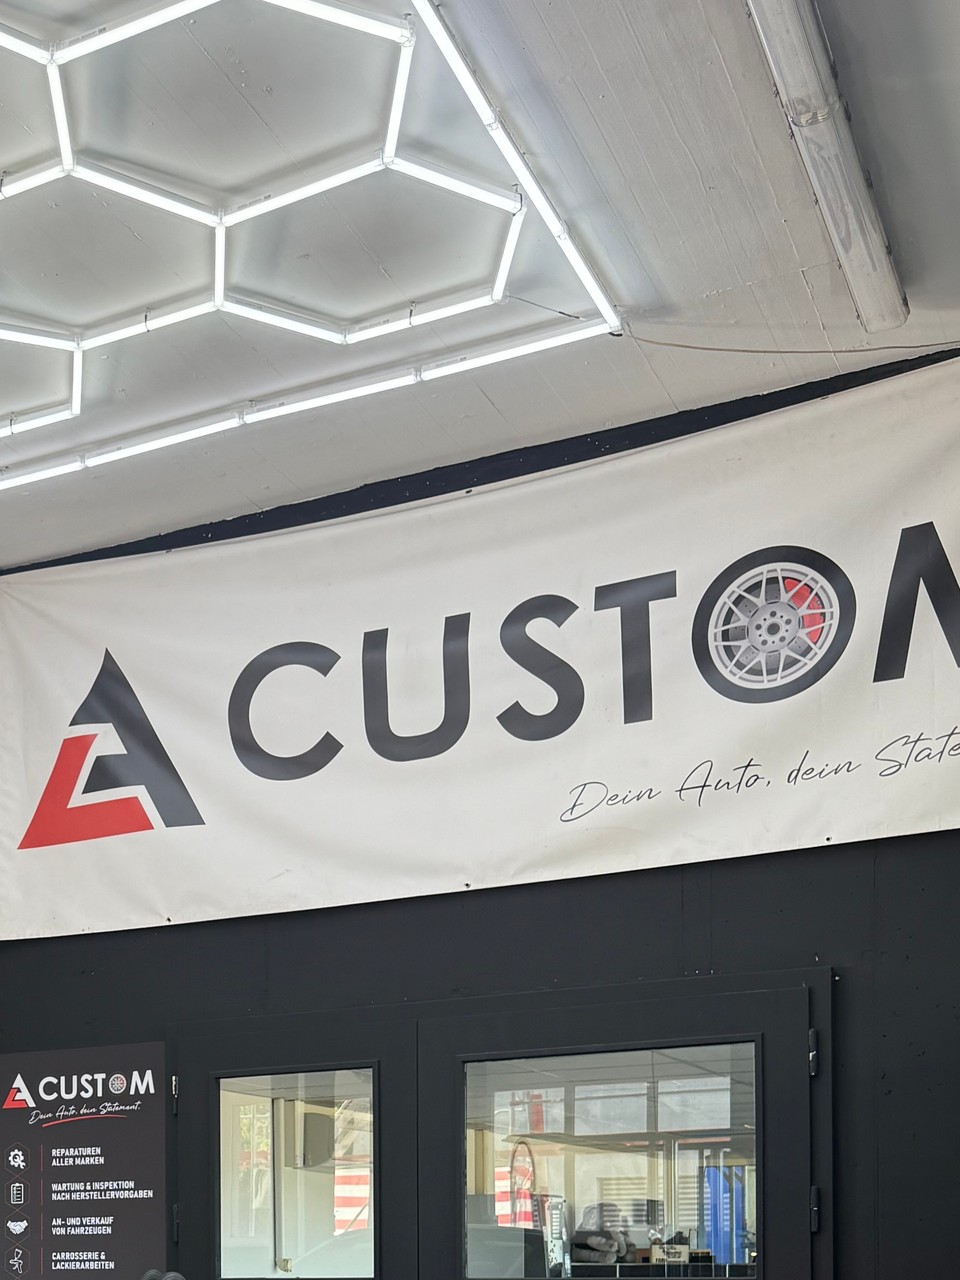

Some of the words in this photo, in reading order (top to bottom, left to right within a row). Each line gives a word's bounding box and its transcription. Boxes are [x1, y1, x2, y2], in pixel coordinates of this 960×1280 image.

[560, 781, 661, 822] Dein
[675, 758, 771, 807] Auto,
[787, 750, 861, 785] dein
[38, 1069, 155, 1101] CUSTOM
[28, 1110, 53, 1125] Dein
[80, 1103, 97, 1115] dein
[51, 1146, 102, 1157] REPARATUREN
[51, 1157, 74, 1167] ALLER
[75, 1156, 105, 1166] MARKEN
[51, 1182, 85, 1191] WARTUNG
[86, 1182, 91, 1190] &
[92, 1180, 135, 1189] INSPEKTION
[51, 1192, 70, 1201] NACH
[71, 1189, 153, 1200] HERSTELLERVORGABEN
[51, 1217, 65, 1226] AN-
[66, 1217, 81, 1226] UND
[81, 1216, 114, 1225] VERKAUF
[51, 1227, 66, 1236] VON
[66, 1226, 112, 1235] FAHRZEUGEN
[51, 1251, 100, 1260] CARROSSERIE
[100, 1251, 106, 1260] &
[51, 1261, 115, 1270] LACKIERARBEITEN
